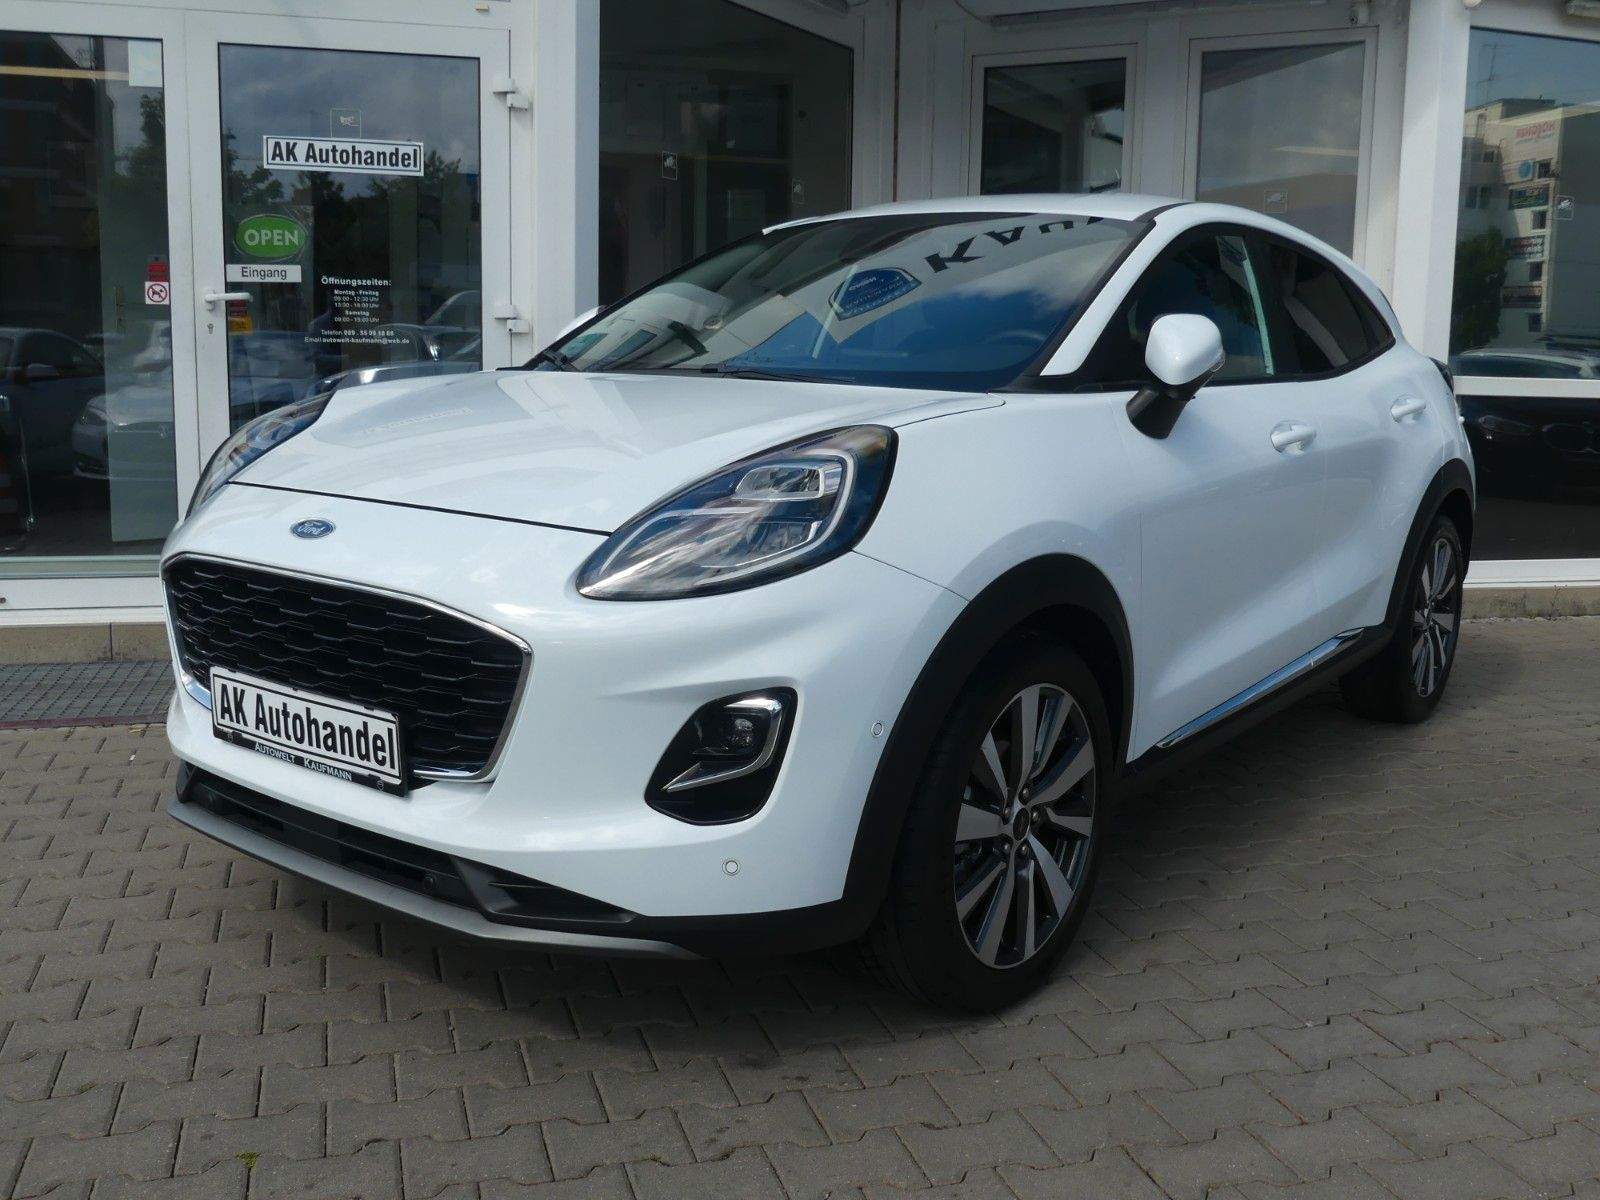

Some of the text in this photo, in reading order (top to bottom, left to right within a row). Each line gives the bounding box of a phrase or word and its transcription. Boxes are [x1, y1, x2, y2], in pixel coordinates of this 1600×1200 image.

[271, 141, 418, 168] AK Autohandel
[243, 229, 299, 247] OPEN
[241, 266, 287, 281] Eingang
[321, 275, 392, 287] Öffnungszeiten:
[297, 521, 326, 536] Ford
[220, 683, 396, 770] AK Autohandel
[254, 742, 352, 781] AUTOWELT KAUFMANN
